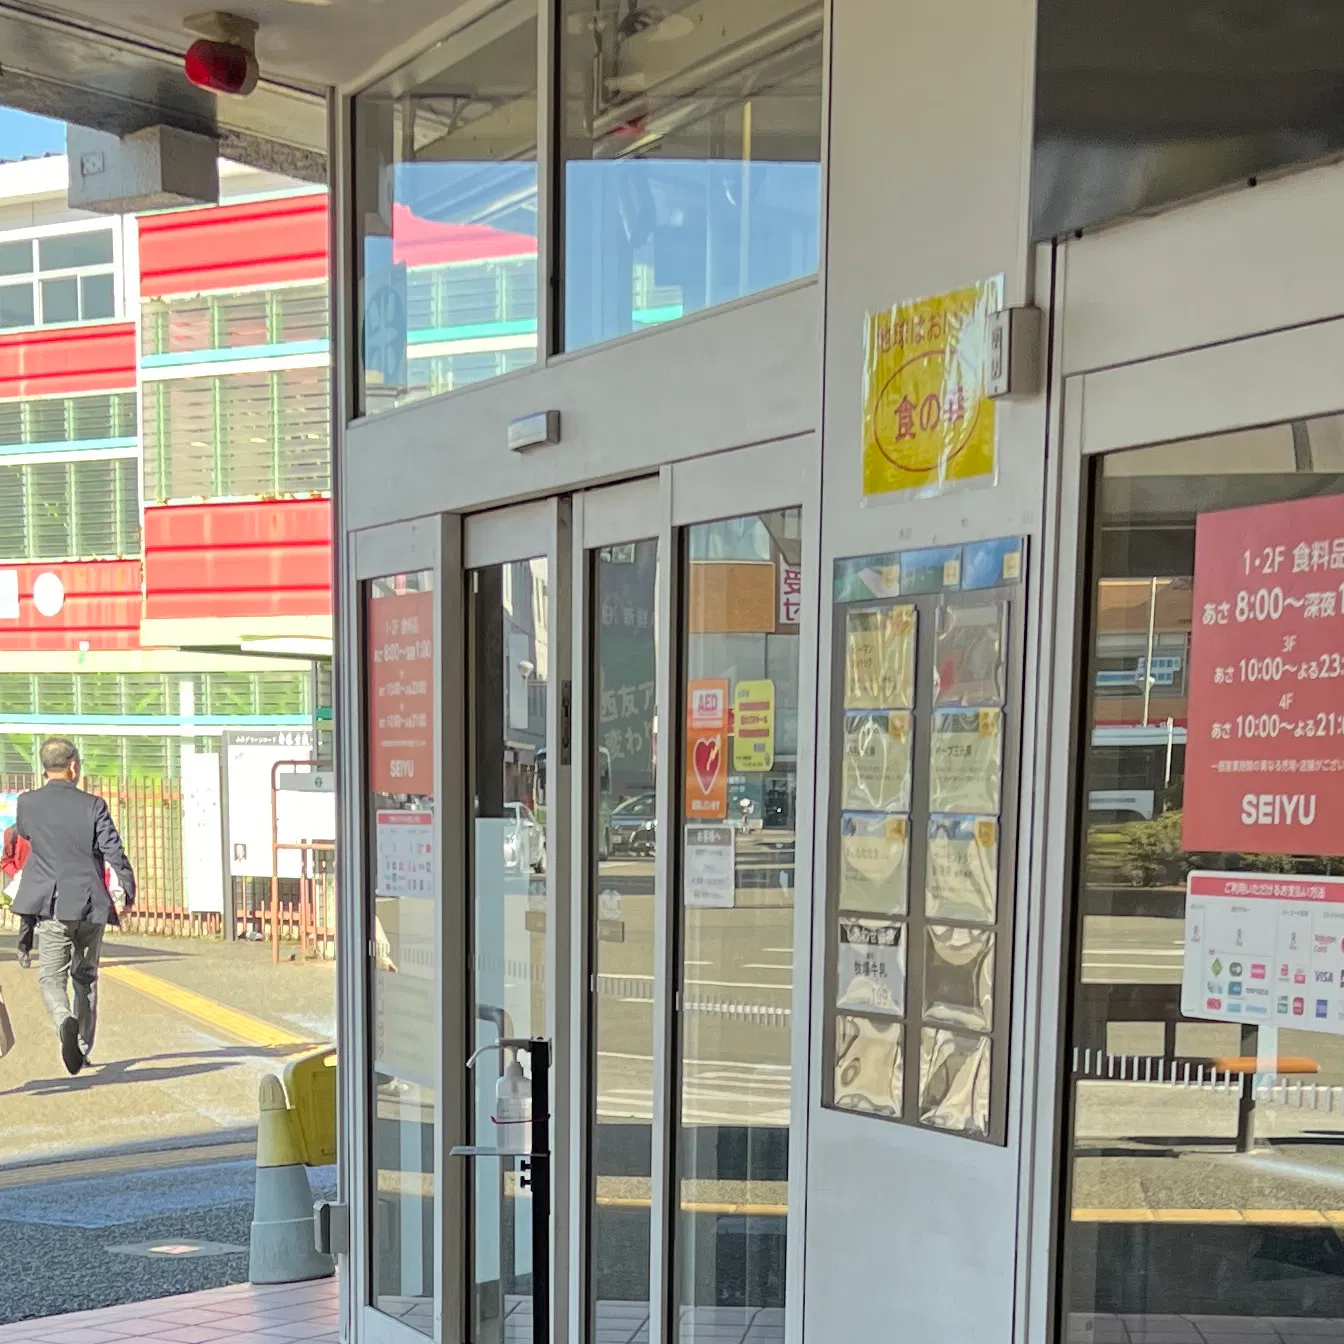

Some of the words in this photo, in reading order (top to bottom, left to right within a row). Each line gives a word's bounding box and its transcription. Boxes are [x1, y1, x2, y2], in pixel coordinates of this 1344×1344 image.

[1202, 601, 1231, 625] あさ
[1282, 635, 1297, 652] 3F
[1214, 666, 1234, 684] あさ
[697, 692, 719, 713] AED
[1278, 692, 1294, 710] 4F
[1211, 722, 1232, 739] あさ
[390, 759, 415, 779] SEIYU
[1241, 793, 1317, 826] SEIYU
[1314, 969, 1334, 983] VISA
